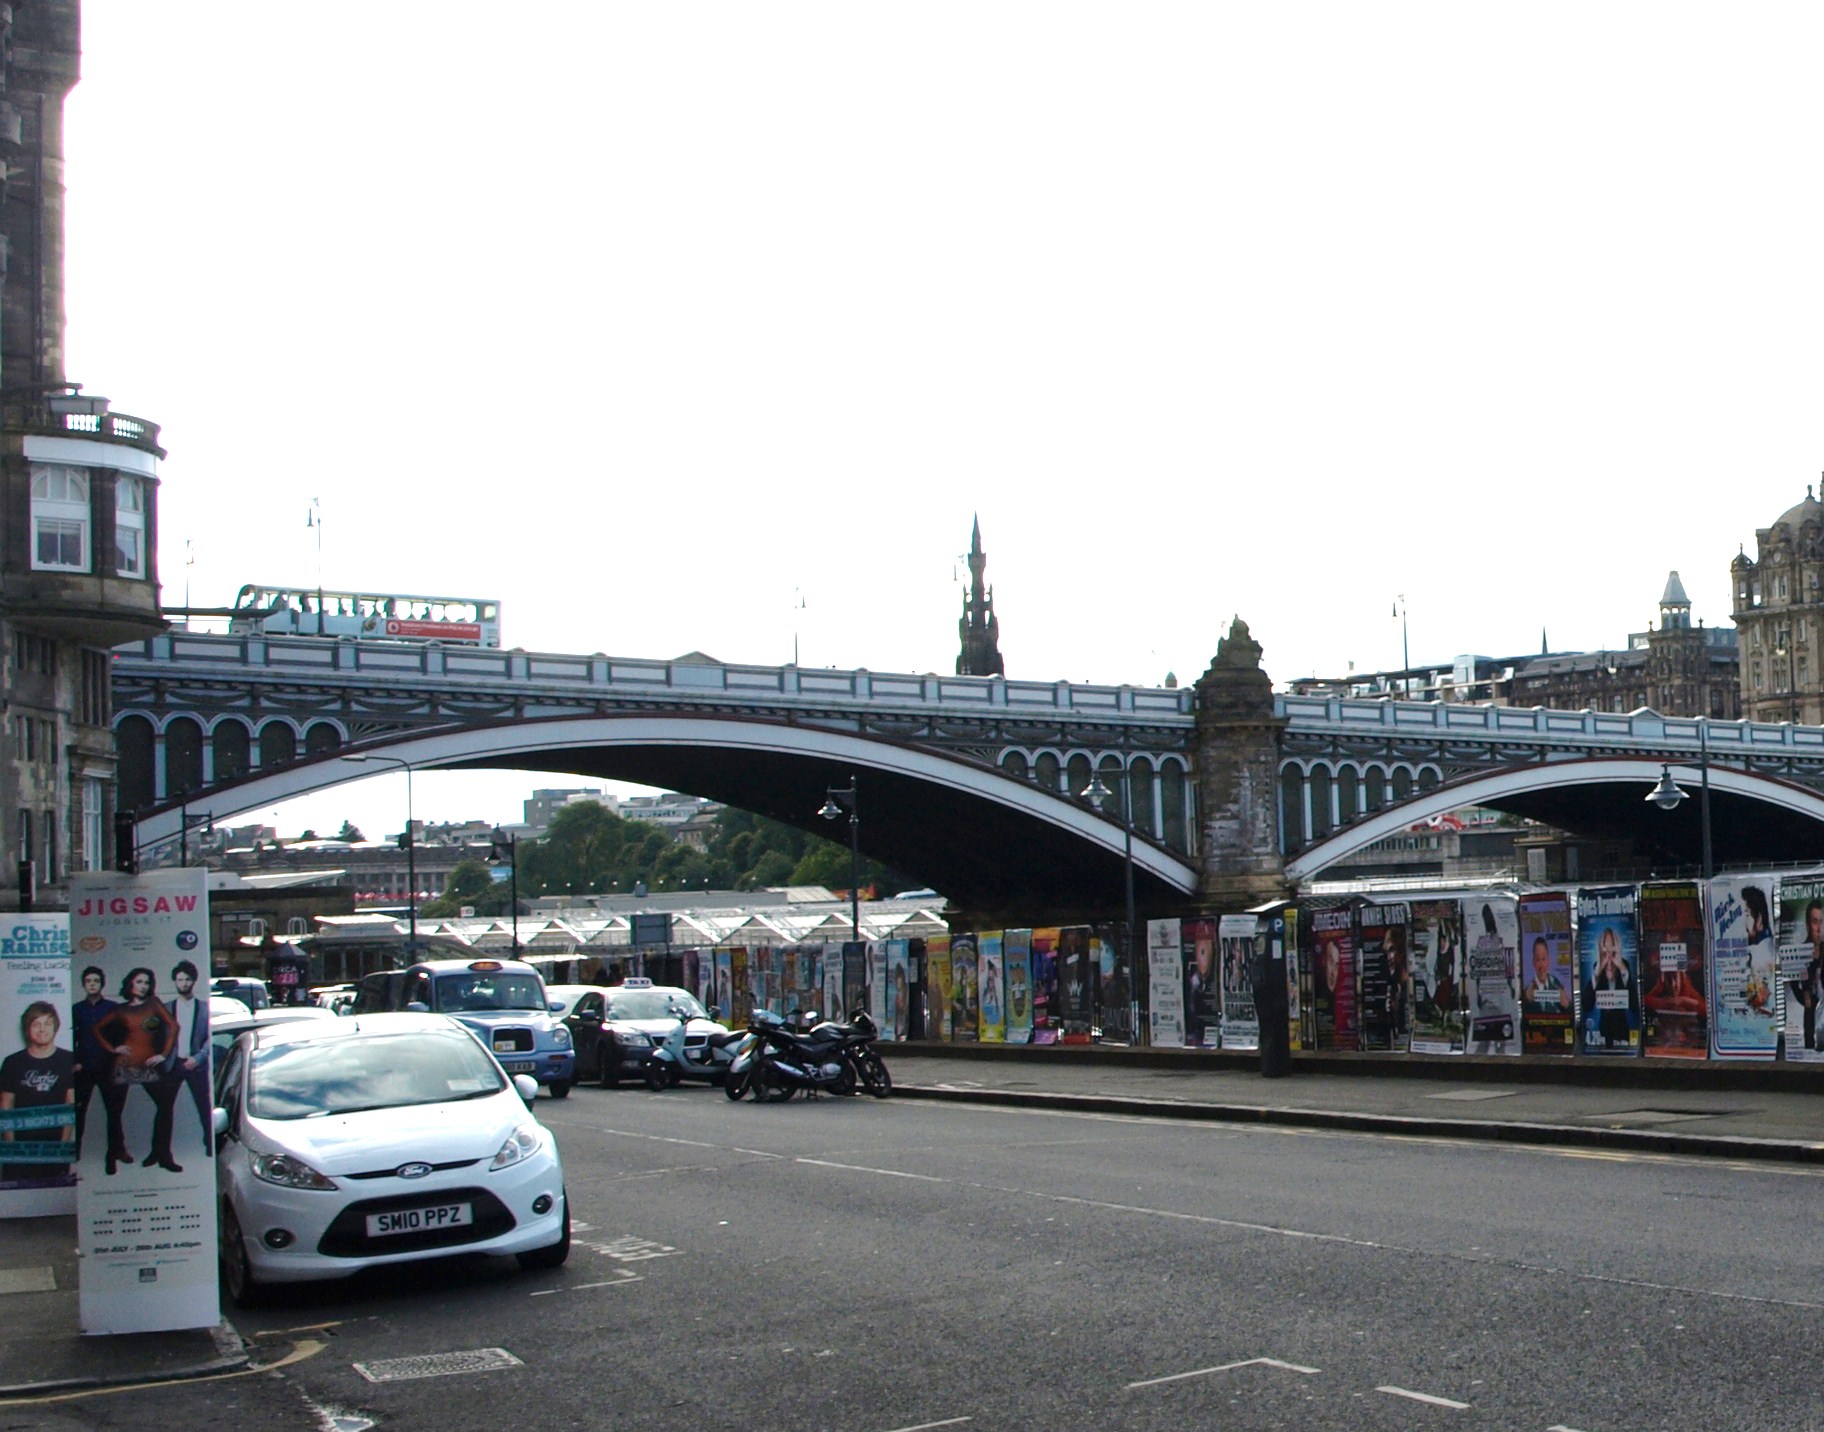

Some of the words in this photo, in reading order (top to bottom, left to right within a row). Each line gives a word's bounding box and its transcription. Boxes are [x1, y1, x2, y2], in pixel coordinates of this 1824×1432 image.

[78, 895, 197, 917] JIGSAW
[12, 924, 69, 942] Chris
[1273, 918, 1283, 932] P
[1, 938, 70, 955] Ramse
[378, 1211, 420, 1232] SM10
[425, 1206, 461, 1226] PPZ
